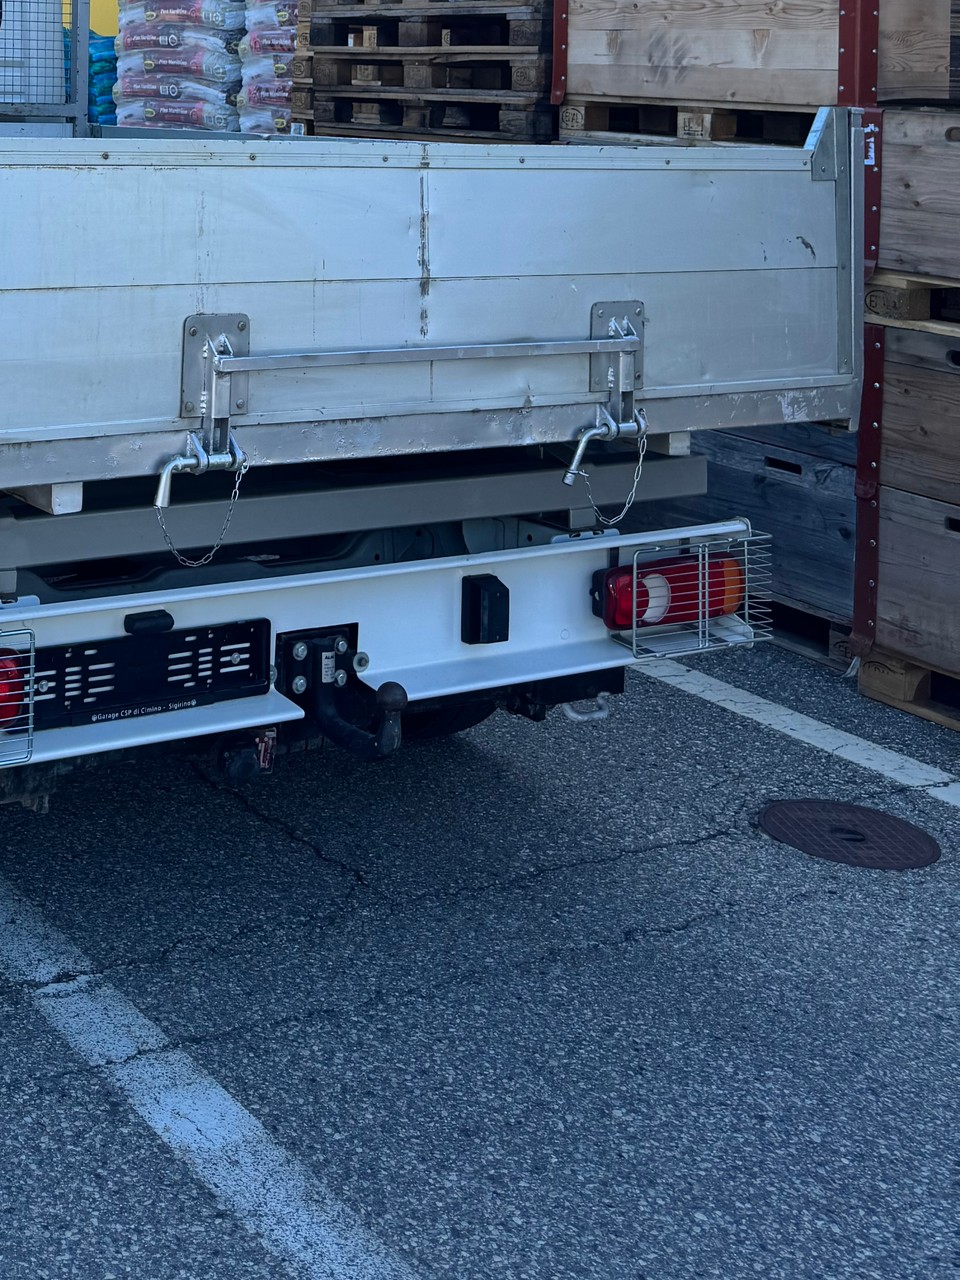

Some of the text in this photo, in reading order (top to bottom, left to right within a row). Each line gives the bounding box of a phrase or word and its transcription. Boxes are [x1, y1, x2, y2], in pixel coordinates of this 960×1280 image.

[97, 713, 119, 721] Garage
[140, 705, 162, 714] Cimino
[168, 700, 191, 710] Sigirino
